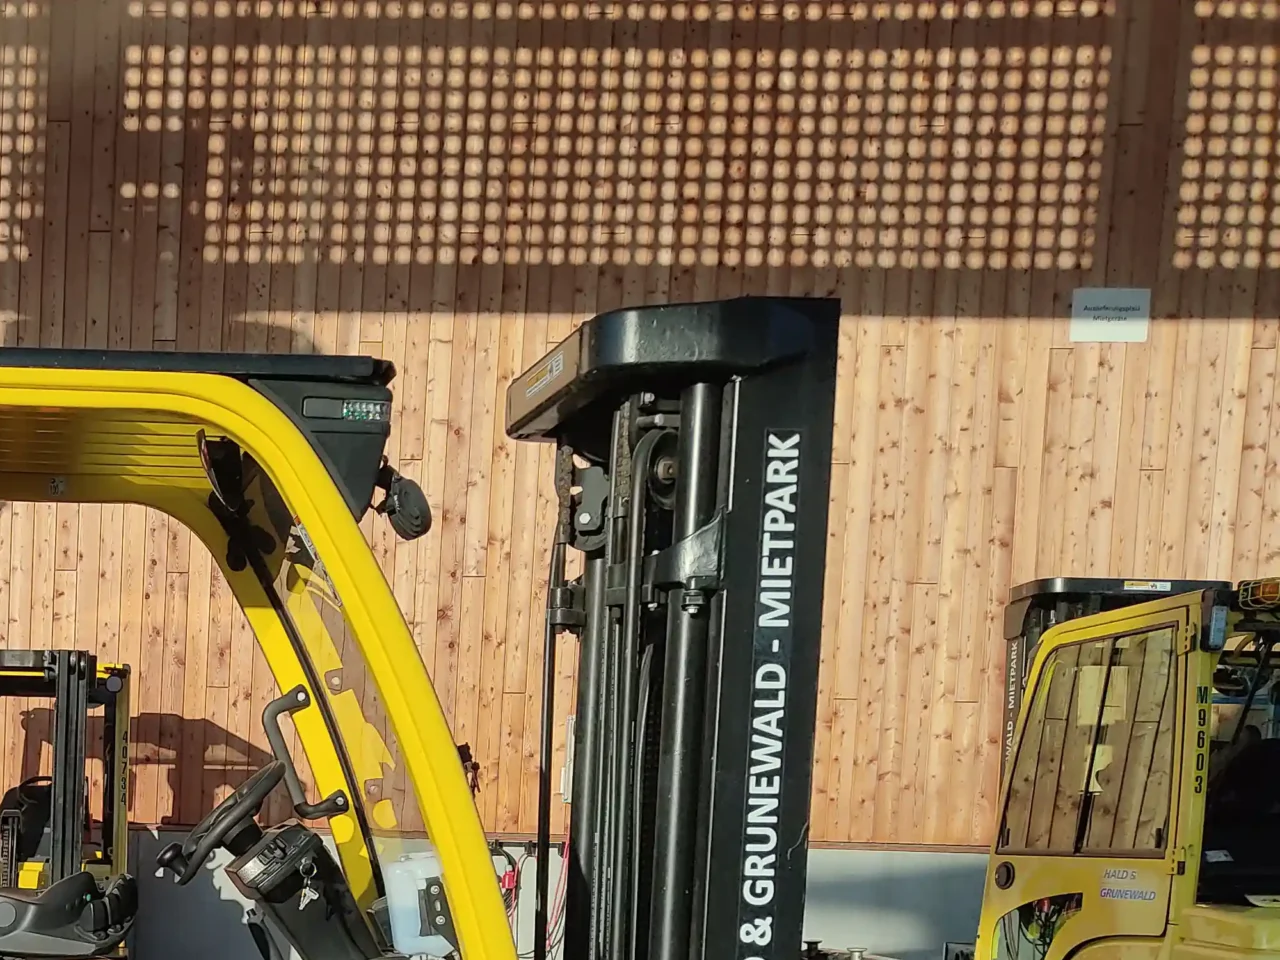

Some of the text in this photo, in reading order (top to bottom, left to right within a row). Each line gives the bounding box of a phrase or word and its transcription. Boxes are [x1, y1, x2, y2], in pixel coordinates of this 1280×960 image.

[757, 433, 801, 628] MIETPARK
[771, 638, 780, 653] -
[1007, 641, 1018, 710] MIETPARK
[1005, 720, 1014, 761] WALD
[1194, 685, 1209, 794] M9603
[120, 730, 128, 806] 40734
[742, 663, 787, 906] GRUNEWALD
[1100, 887, 1156, 901] GRUNEWALD
[1103, 868, 1129, 880] HALD
[739, 916, 773, 947] &
